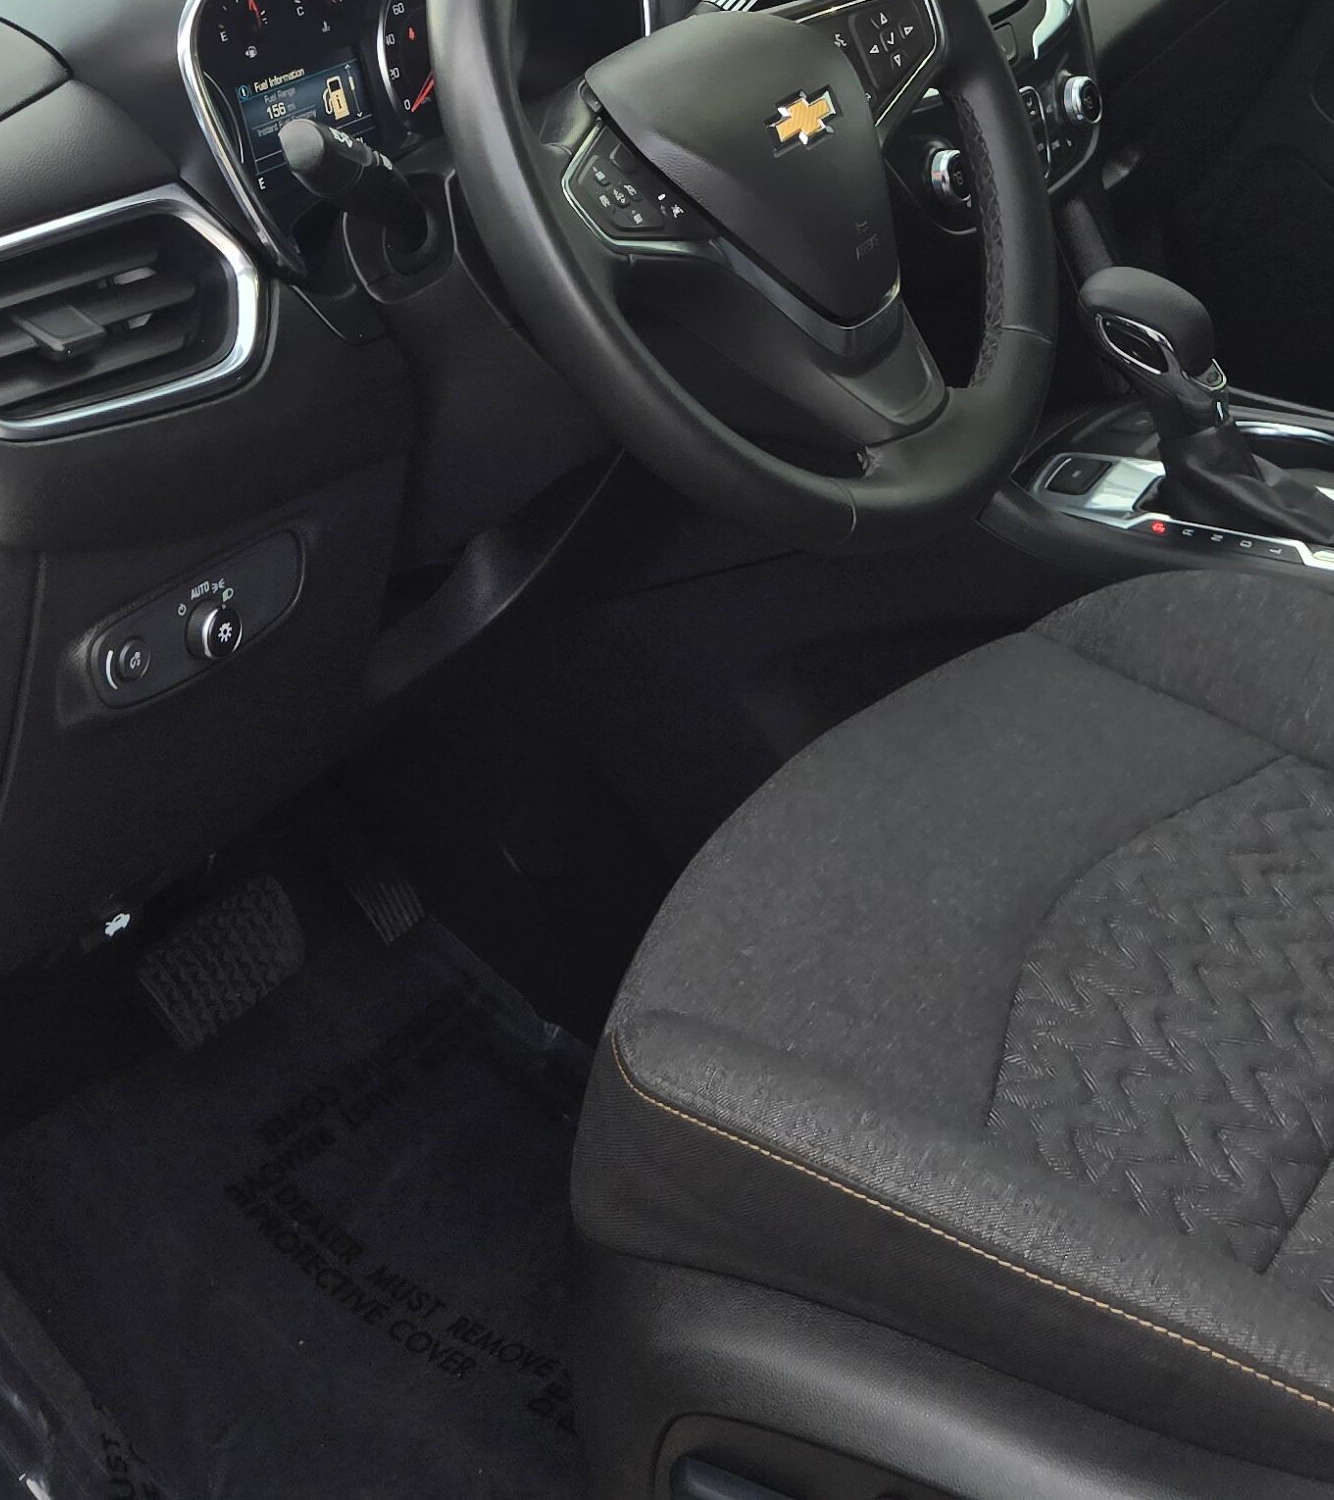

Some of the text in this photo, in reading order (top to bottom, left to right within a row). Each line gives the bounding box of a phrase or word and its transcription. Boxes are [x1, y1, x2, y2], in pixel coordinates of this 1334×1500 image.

[297, 6, 305, 16] C
[392, 3, 404, 15] 60
[220, 31, 228, 42] E
[254, 68, 305, 92] Fuel Information
[267, 102, 287, 119] 156
[404, 99, 411, 110] 0
[258, 177, 266, 189] E
[190, 581, 210, 600] AUTO
[275, 1184, 561, 1379] DEALER MUST REMOVE
[245, 1201, 477, 1381] PROTECTIVE COVER
